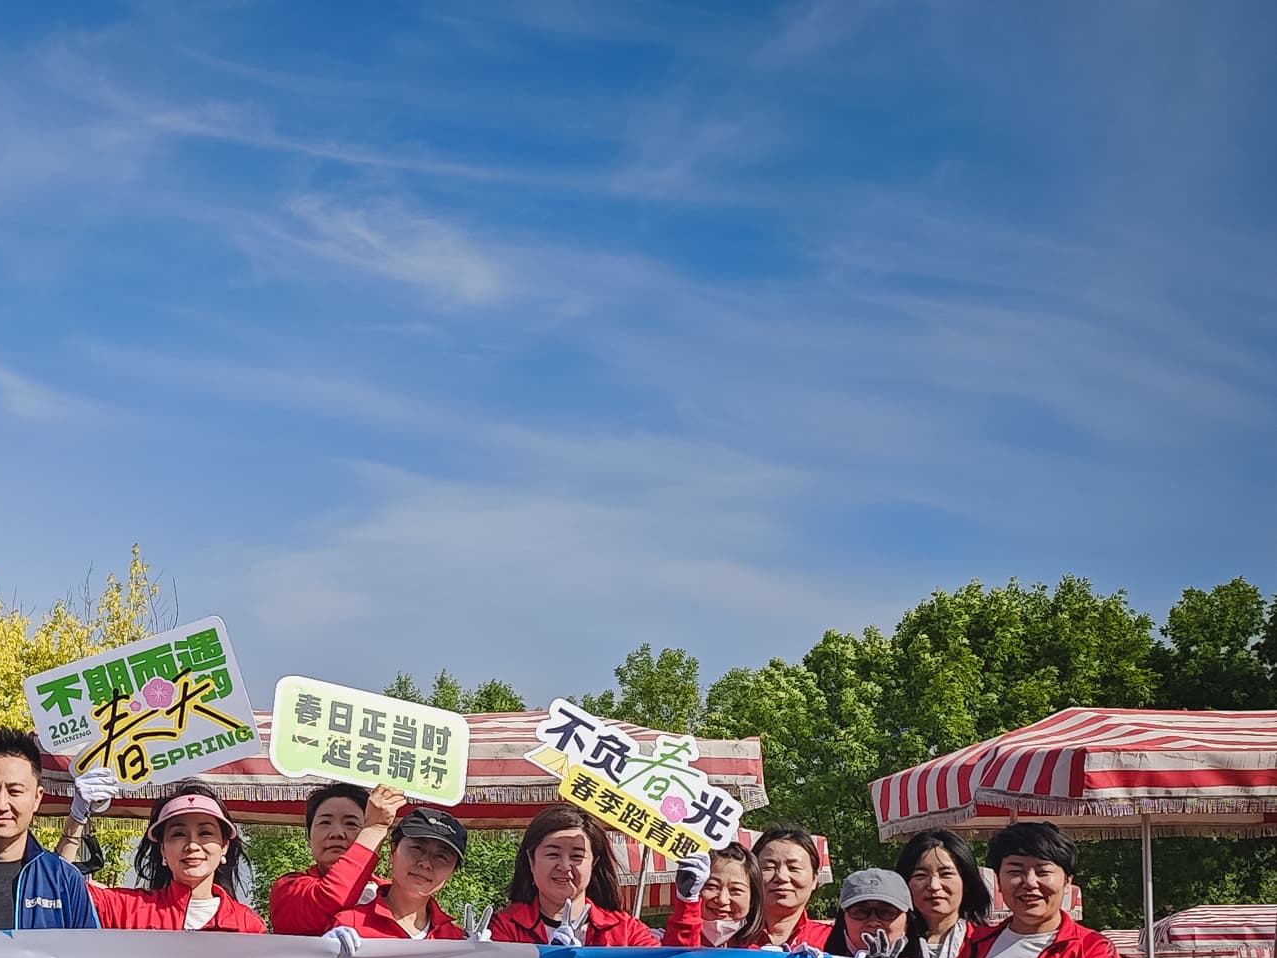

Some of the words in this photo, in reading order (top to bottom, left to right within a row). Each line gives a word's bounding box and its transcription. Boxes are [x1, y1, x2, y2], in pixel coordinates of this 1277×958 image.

[48, 715, 90, 740] 2024
[53, 729, 92, 747] SHINING
[150, 725, 255, 771] SPRING
[294, 693, 452, 756] 春日正当时
[291, 733, 448, 790] 一起去骑行
[545, 707, 734, 842] 不负春光
[570, 772, 701, 858] 春季踏青趣
